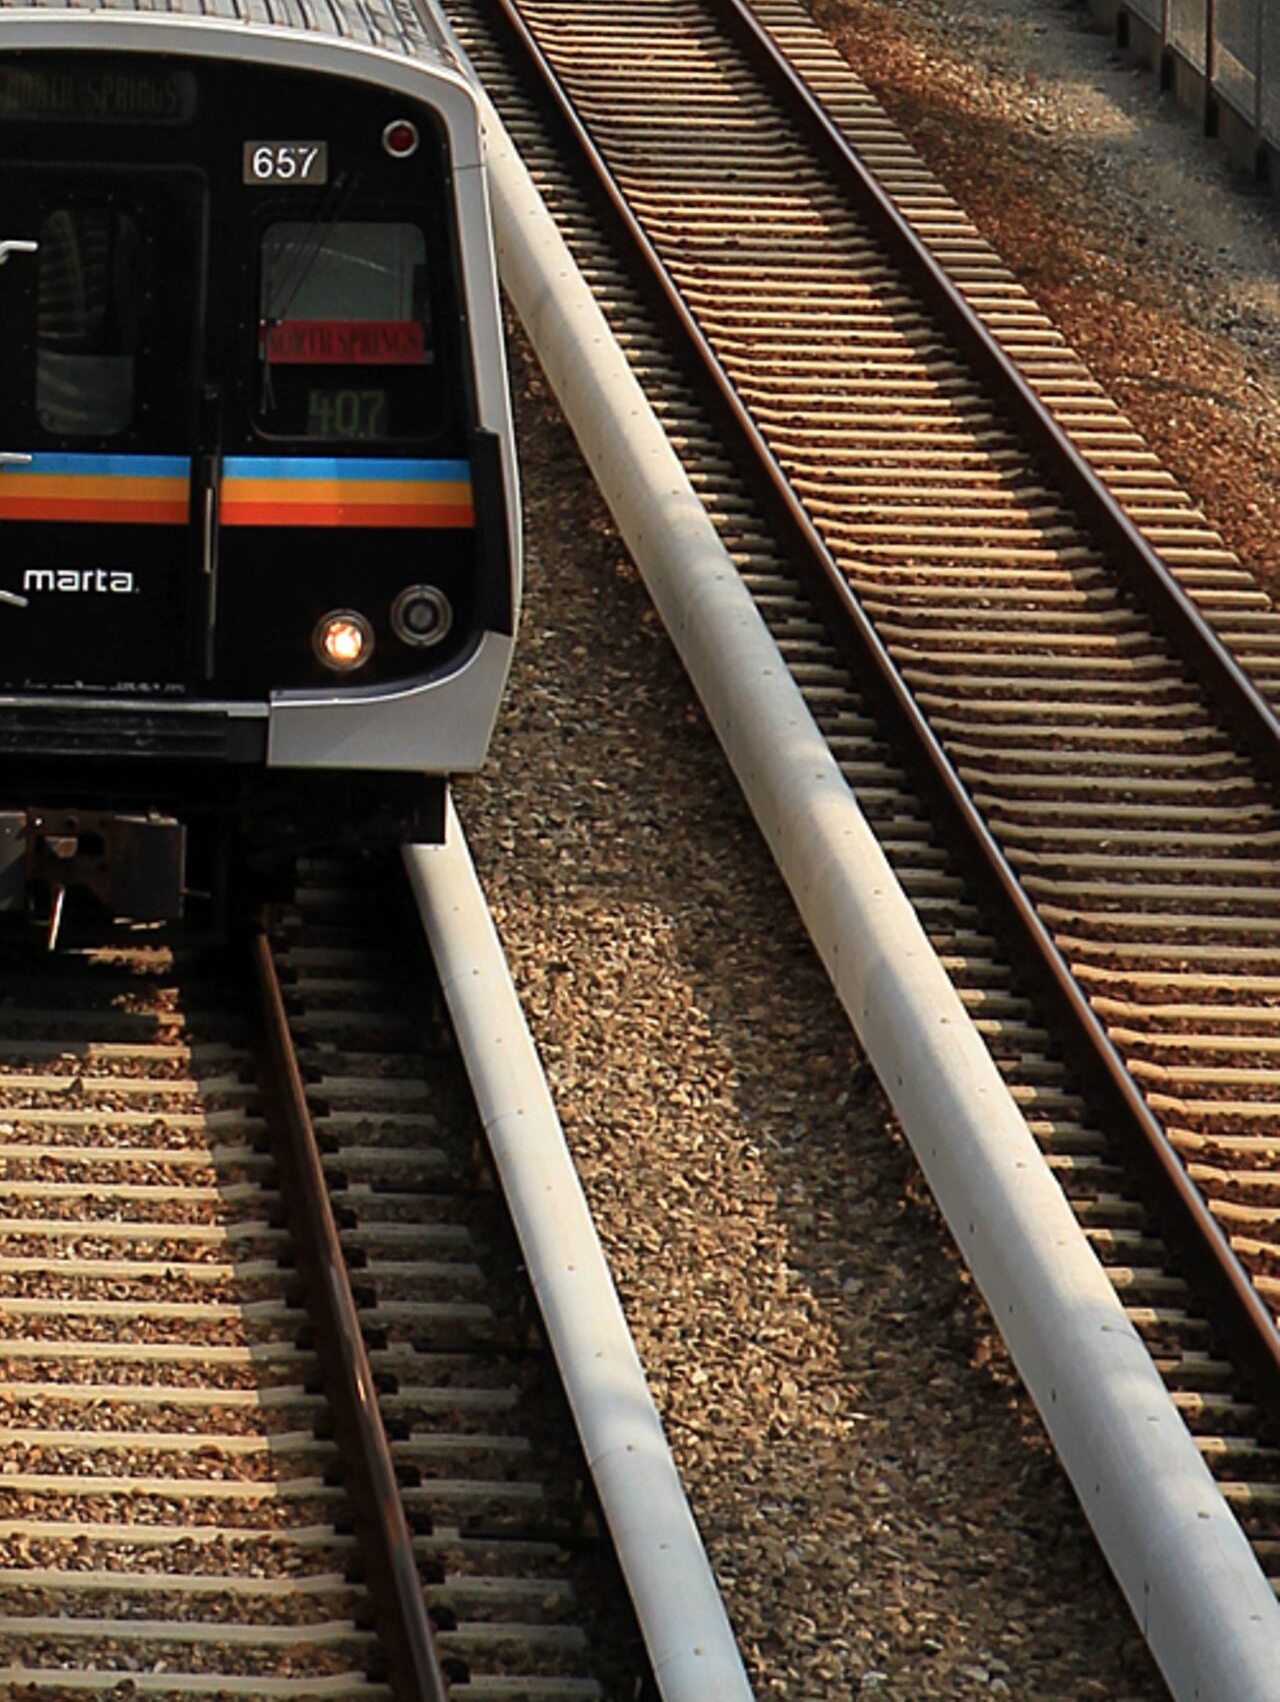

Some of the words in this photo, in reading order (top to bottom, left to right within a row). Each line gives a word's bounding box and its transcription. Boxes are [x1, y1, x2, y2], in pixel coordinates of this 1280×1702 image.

[252, 146, 318, 178] 657
[308, 389, 385, 437] 407
[23, 567, 134, 593] marta
